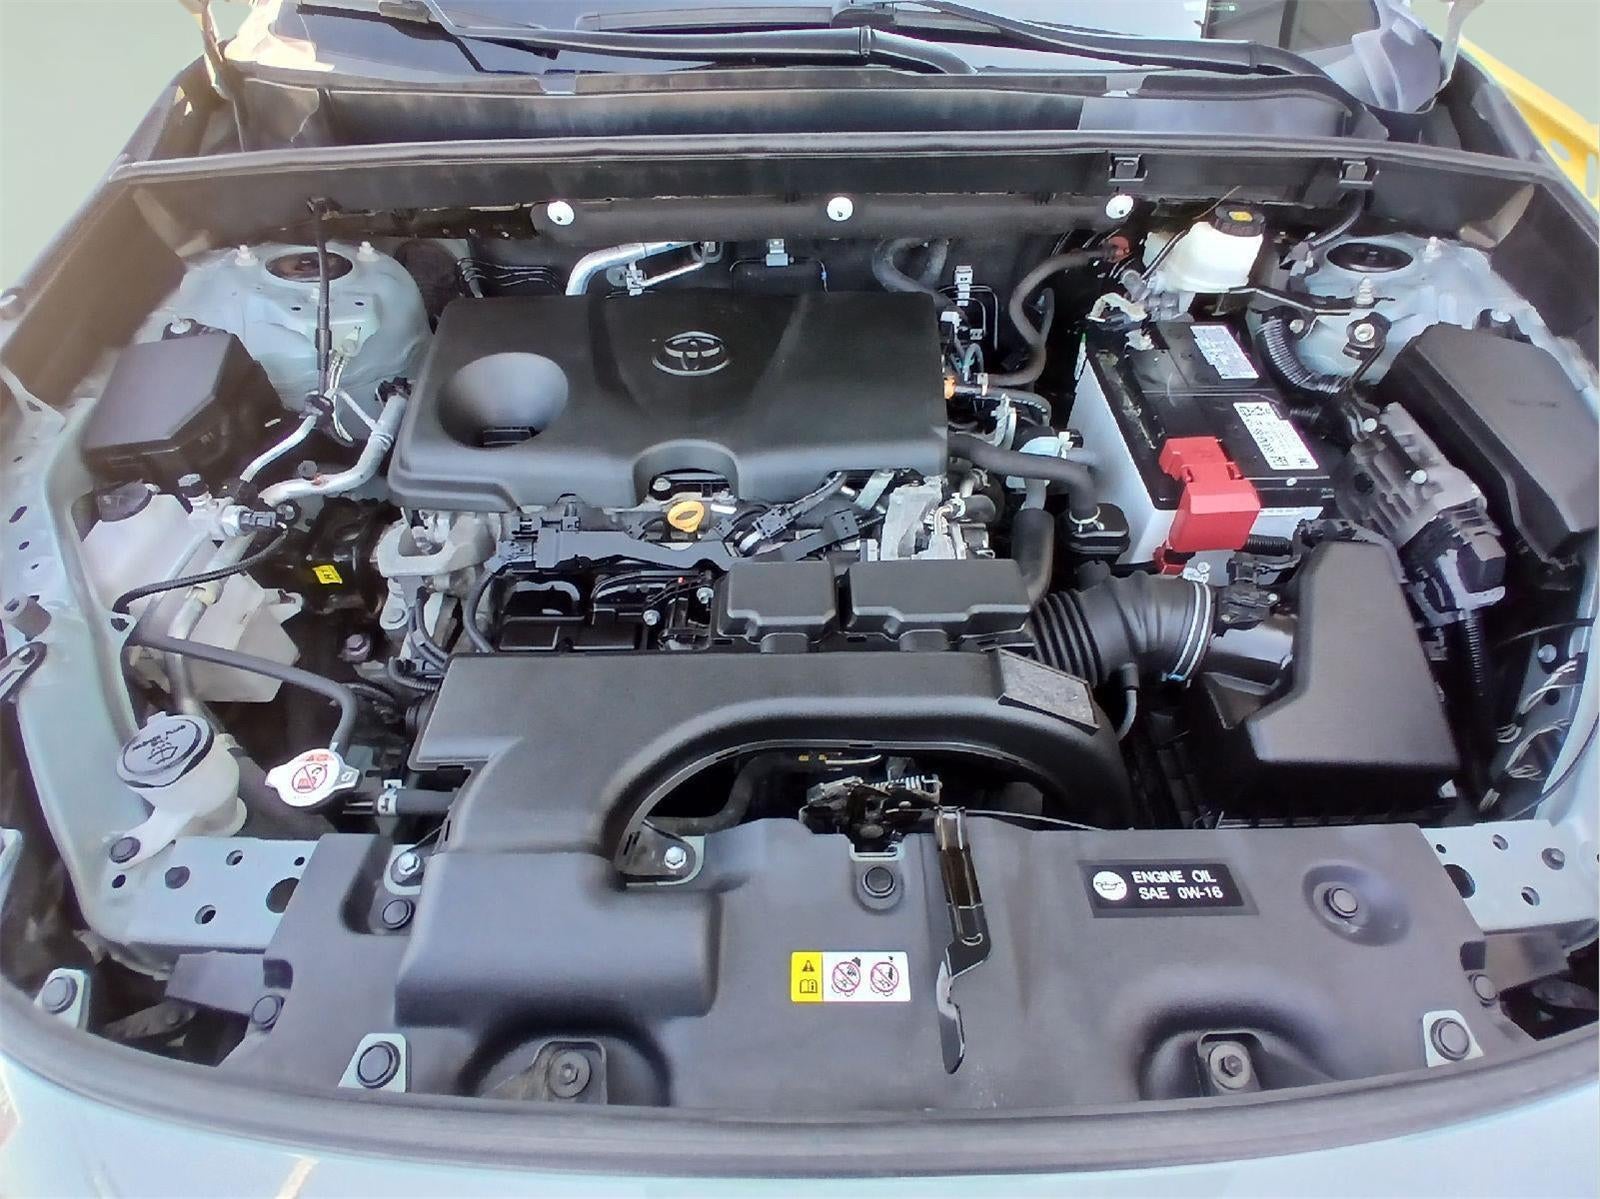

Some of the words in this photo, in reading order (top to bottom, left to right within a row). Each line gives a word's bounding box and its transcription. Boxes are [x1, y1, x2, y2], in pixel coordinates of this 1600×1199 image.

[1131, 870, 1185, 883] ENGINE
[1192, 870, 1216, 882] OIL
[1139, 887, 1170, 899] SAE
[1177, 886, 1223, 899] 0W-16
